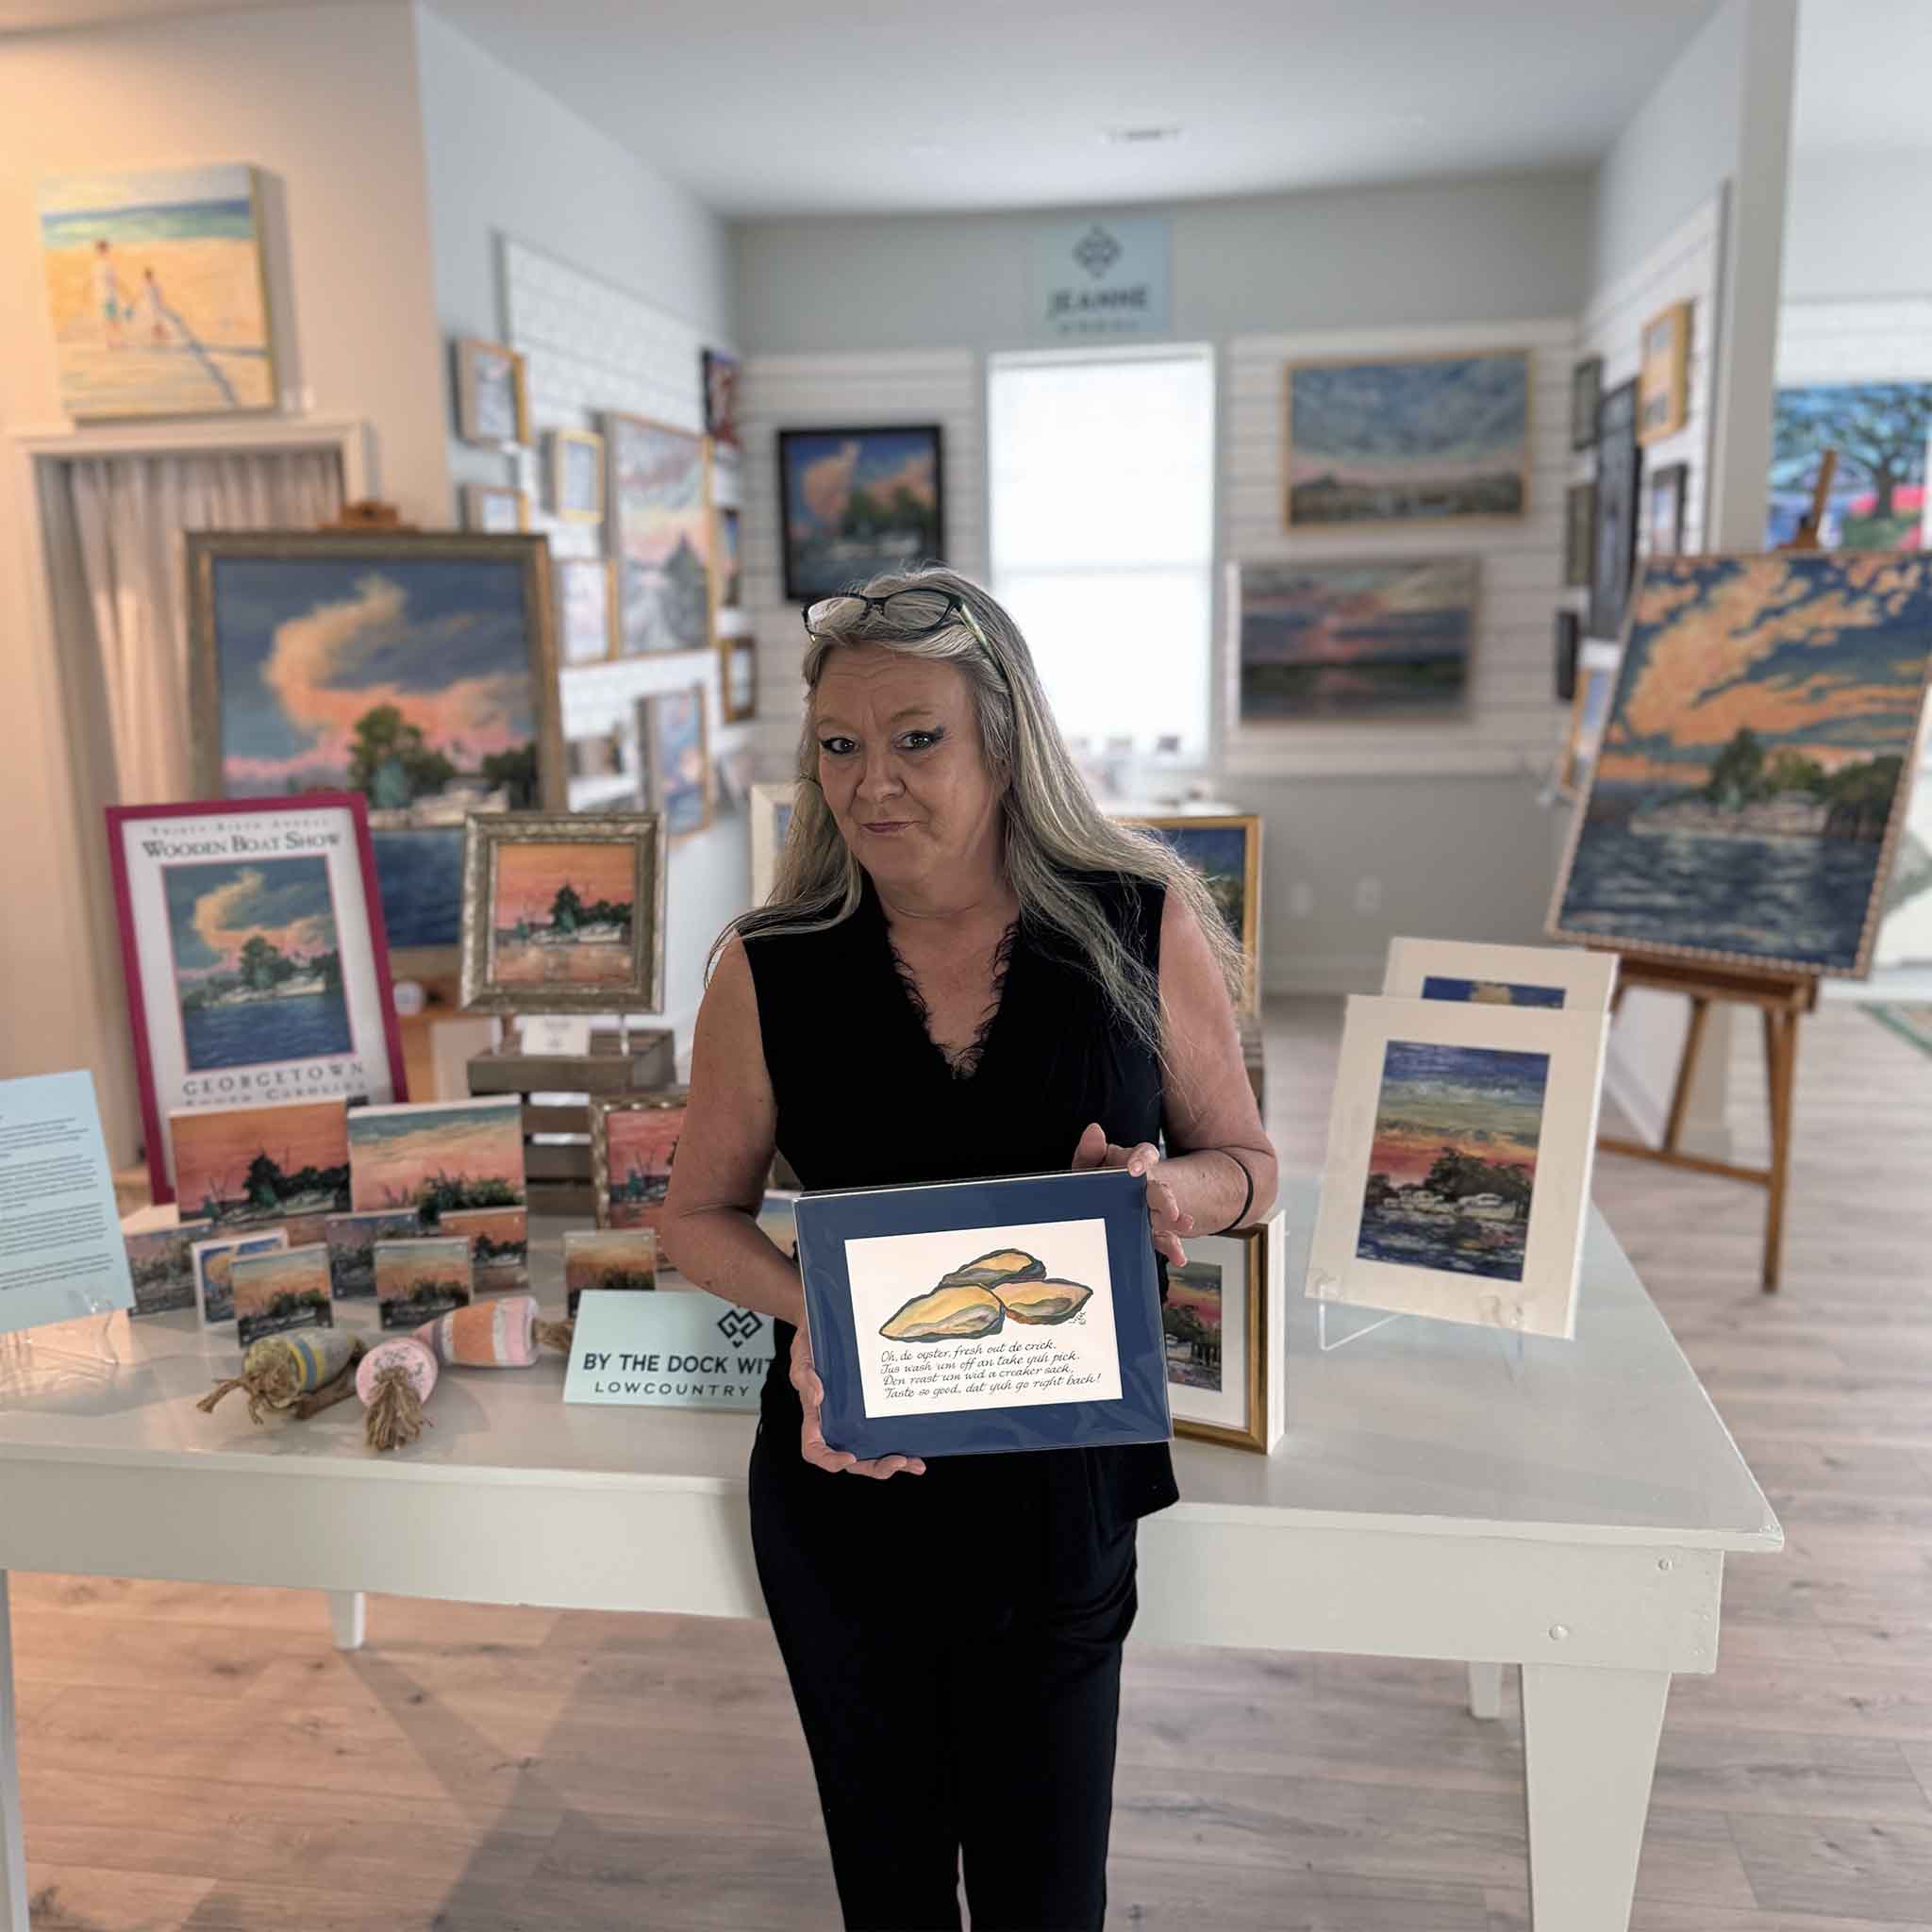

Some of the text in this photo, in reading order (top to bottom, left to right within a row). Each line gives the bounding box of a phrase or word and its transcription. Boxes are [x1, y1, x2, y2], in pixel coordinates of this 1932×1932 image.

[142, 830, 341, 858] WOODEN BOAT SHOW
[182, 1062, 363, 1095] GEORGETOWN
[900, 1348, 912, 1360] de
[953, 1344, 982, 1358] fresh
[987, 1342, 1006, 1354] out
[1008, 1341, 1022, 1353] de
[583, 1353, 772, 1374] BY THE DOCK WI
[905, 1361, 931, 1372] wash
[937, 1362, 956, 1371] um
[960, 1357, 976, 1371] off
[997, 1354, 1023, 1366] take
[1026, 1352, 1048, 1366] yuh
[883, 1374, 906, 1386] Den
[965, 1369, 986, 1380] wid
[885, 1387, 914, 1399] Taste
[965, 1382, 986, 1393] dat
[990, 1379, 1012, 1391] yuh
[1015, 1381, 1029, 1392] go
[1033, 1375, 1063, 1390] right
[1066, 1373, 1102, 1386] back!
[594, 1380, 750, 1397] LOWCOUNTRY
